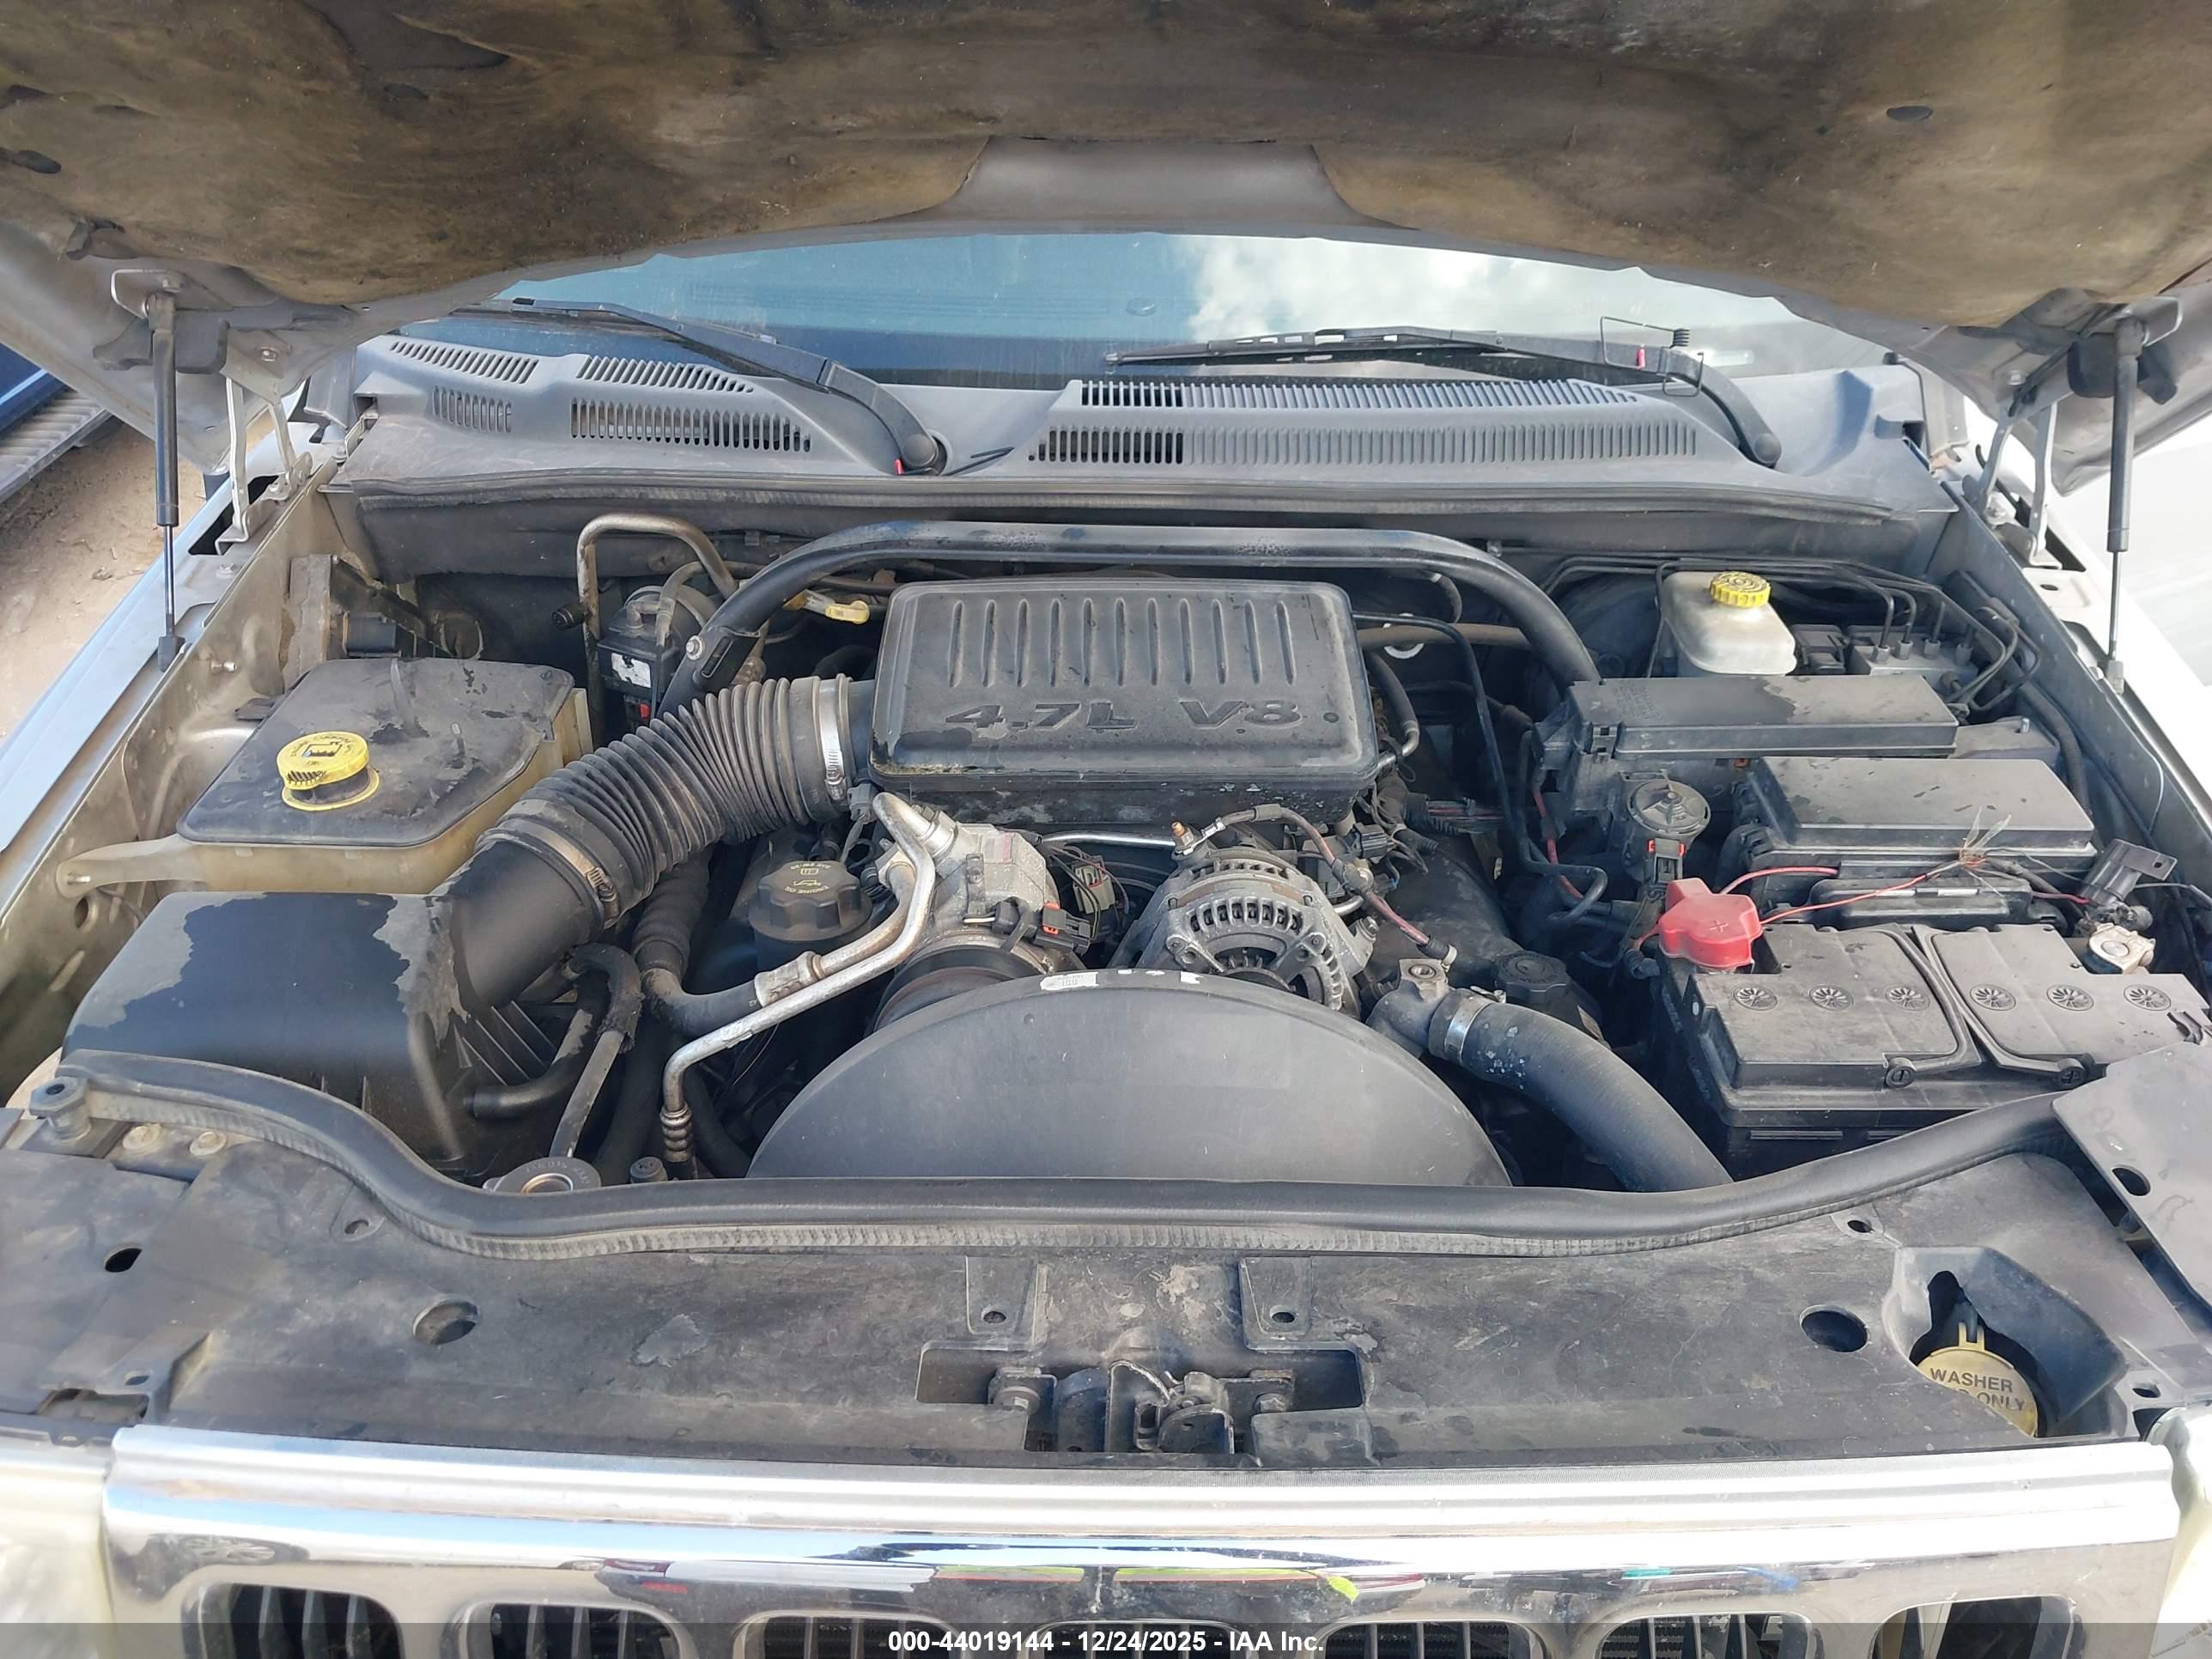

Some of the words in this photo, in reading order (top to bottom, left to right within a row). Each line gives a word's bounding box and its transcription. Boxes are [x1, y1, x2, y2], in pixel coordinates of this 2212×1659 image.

[945, 702, 1137, 729] 4.7L
[1179, 700, 1302, 728] V8
[1930, 1368, 2013, 1393] WASHER
[1977, 1392, 2025, 1411] ONLY
